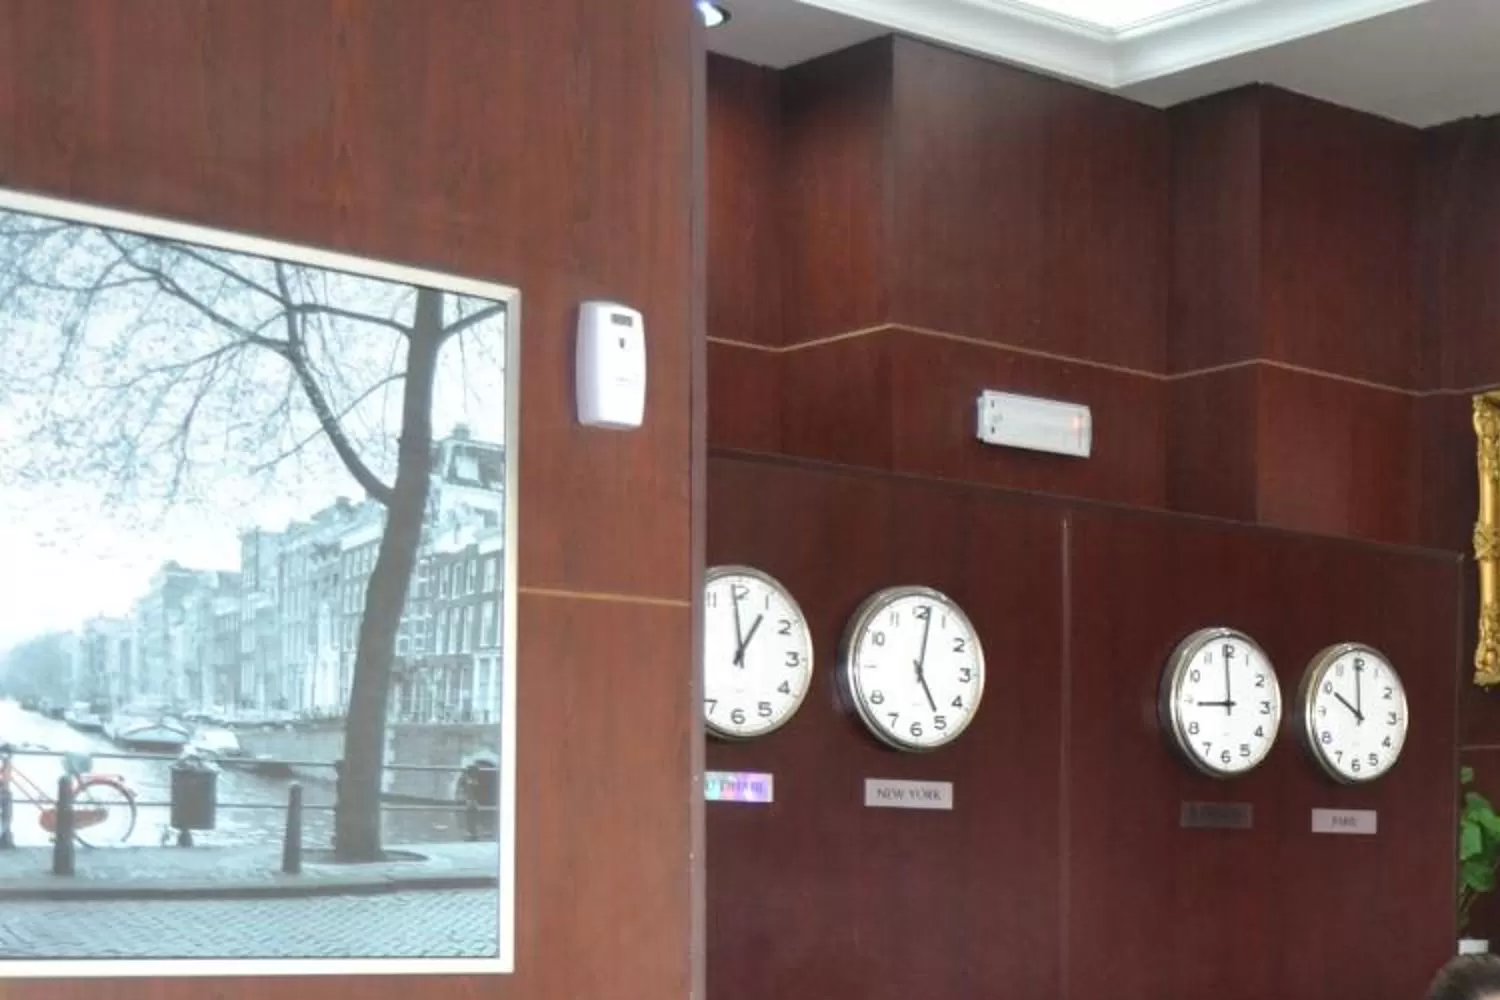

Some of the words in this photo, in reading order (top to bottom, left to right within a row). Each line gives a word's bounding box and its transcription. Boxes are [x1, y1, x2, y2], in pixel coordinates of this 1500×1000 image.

[777, 619, 793, 636] 2
[952, 637, 966, 653] 2
[785, 651, 800, 668] 3
[958, 667, 972, 683] 3
[1255, 673, 1265, 688] 2
[777, 680, 792, 696] 4
[1382, 686, 1393, 700] 2
[869, 689, 885, 705] 8
[951, 695, 964, 710] 4
[757, 701, 773, 718] 5
[1260, 701, 1271, 715] 3
[731, 708, 746, 726] 6
[887, 712, 900, 728] 7
[933, 714, 948, 731] 5
[1387, 711, 1398, 726] 3
[909, 722, 924, 738] 6
[1188, 721, 1200, 735] 8
[1253, 725, 1264, 738] 4
[1321, 730, 1333, 745] 8
[1381, 736, 1392, 750] 4
[1202, 741, 1212, 757] 7
[1220, 749, 1232, 764] 6
[1240, 743, 1251, 757] 5
[1351, 758, 1361, 773] 6
[1368, 752, 1379, 767] 5
